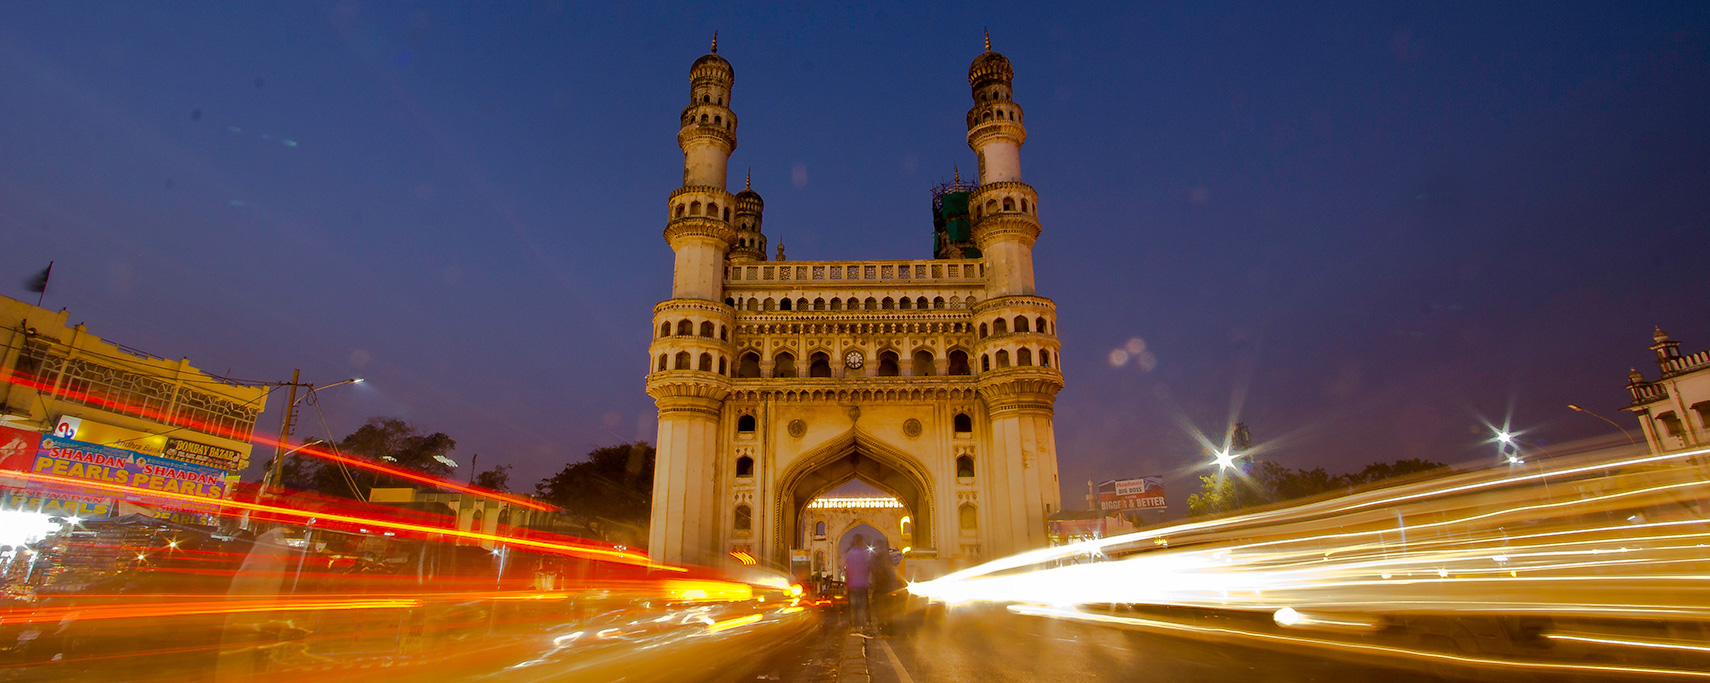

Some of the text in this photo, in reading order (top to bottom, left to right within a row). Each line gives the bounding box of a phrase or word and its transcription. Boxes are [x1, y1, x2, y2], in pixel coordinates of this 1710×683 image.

[50, 447, 126, 469] SHAADAN
[143, 444, 162, 454] Bank
[176, 440, 210, 456] BOMBAY
[209, 447, 235, 460] BAZAR
[35, 456, 129, 484] PEARLS
[144, 463, 218, 485] SHAADAN
[132, 472, 222, 499] PEARLS
[10, 496, 108, 515] PEARLS
[23, 490, 104, 504] SHAADAN
[1128, 499, 1135, 508] &
[1136, 496, 1165, 507] BETTER
